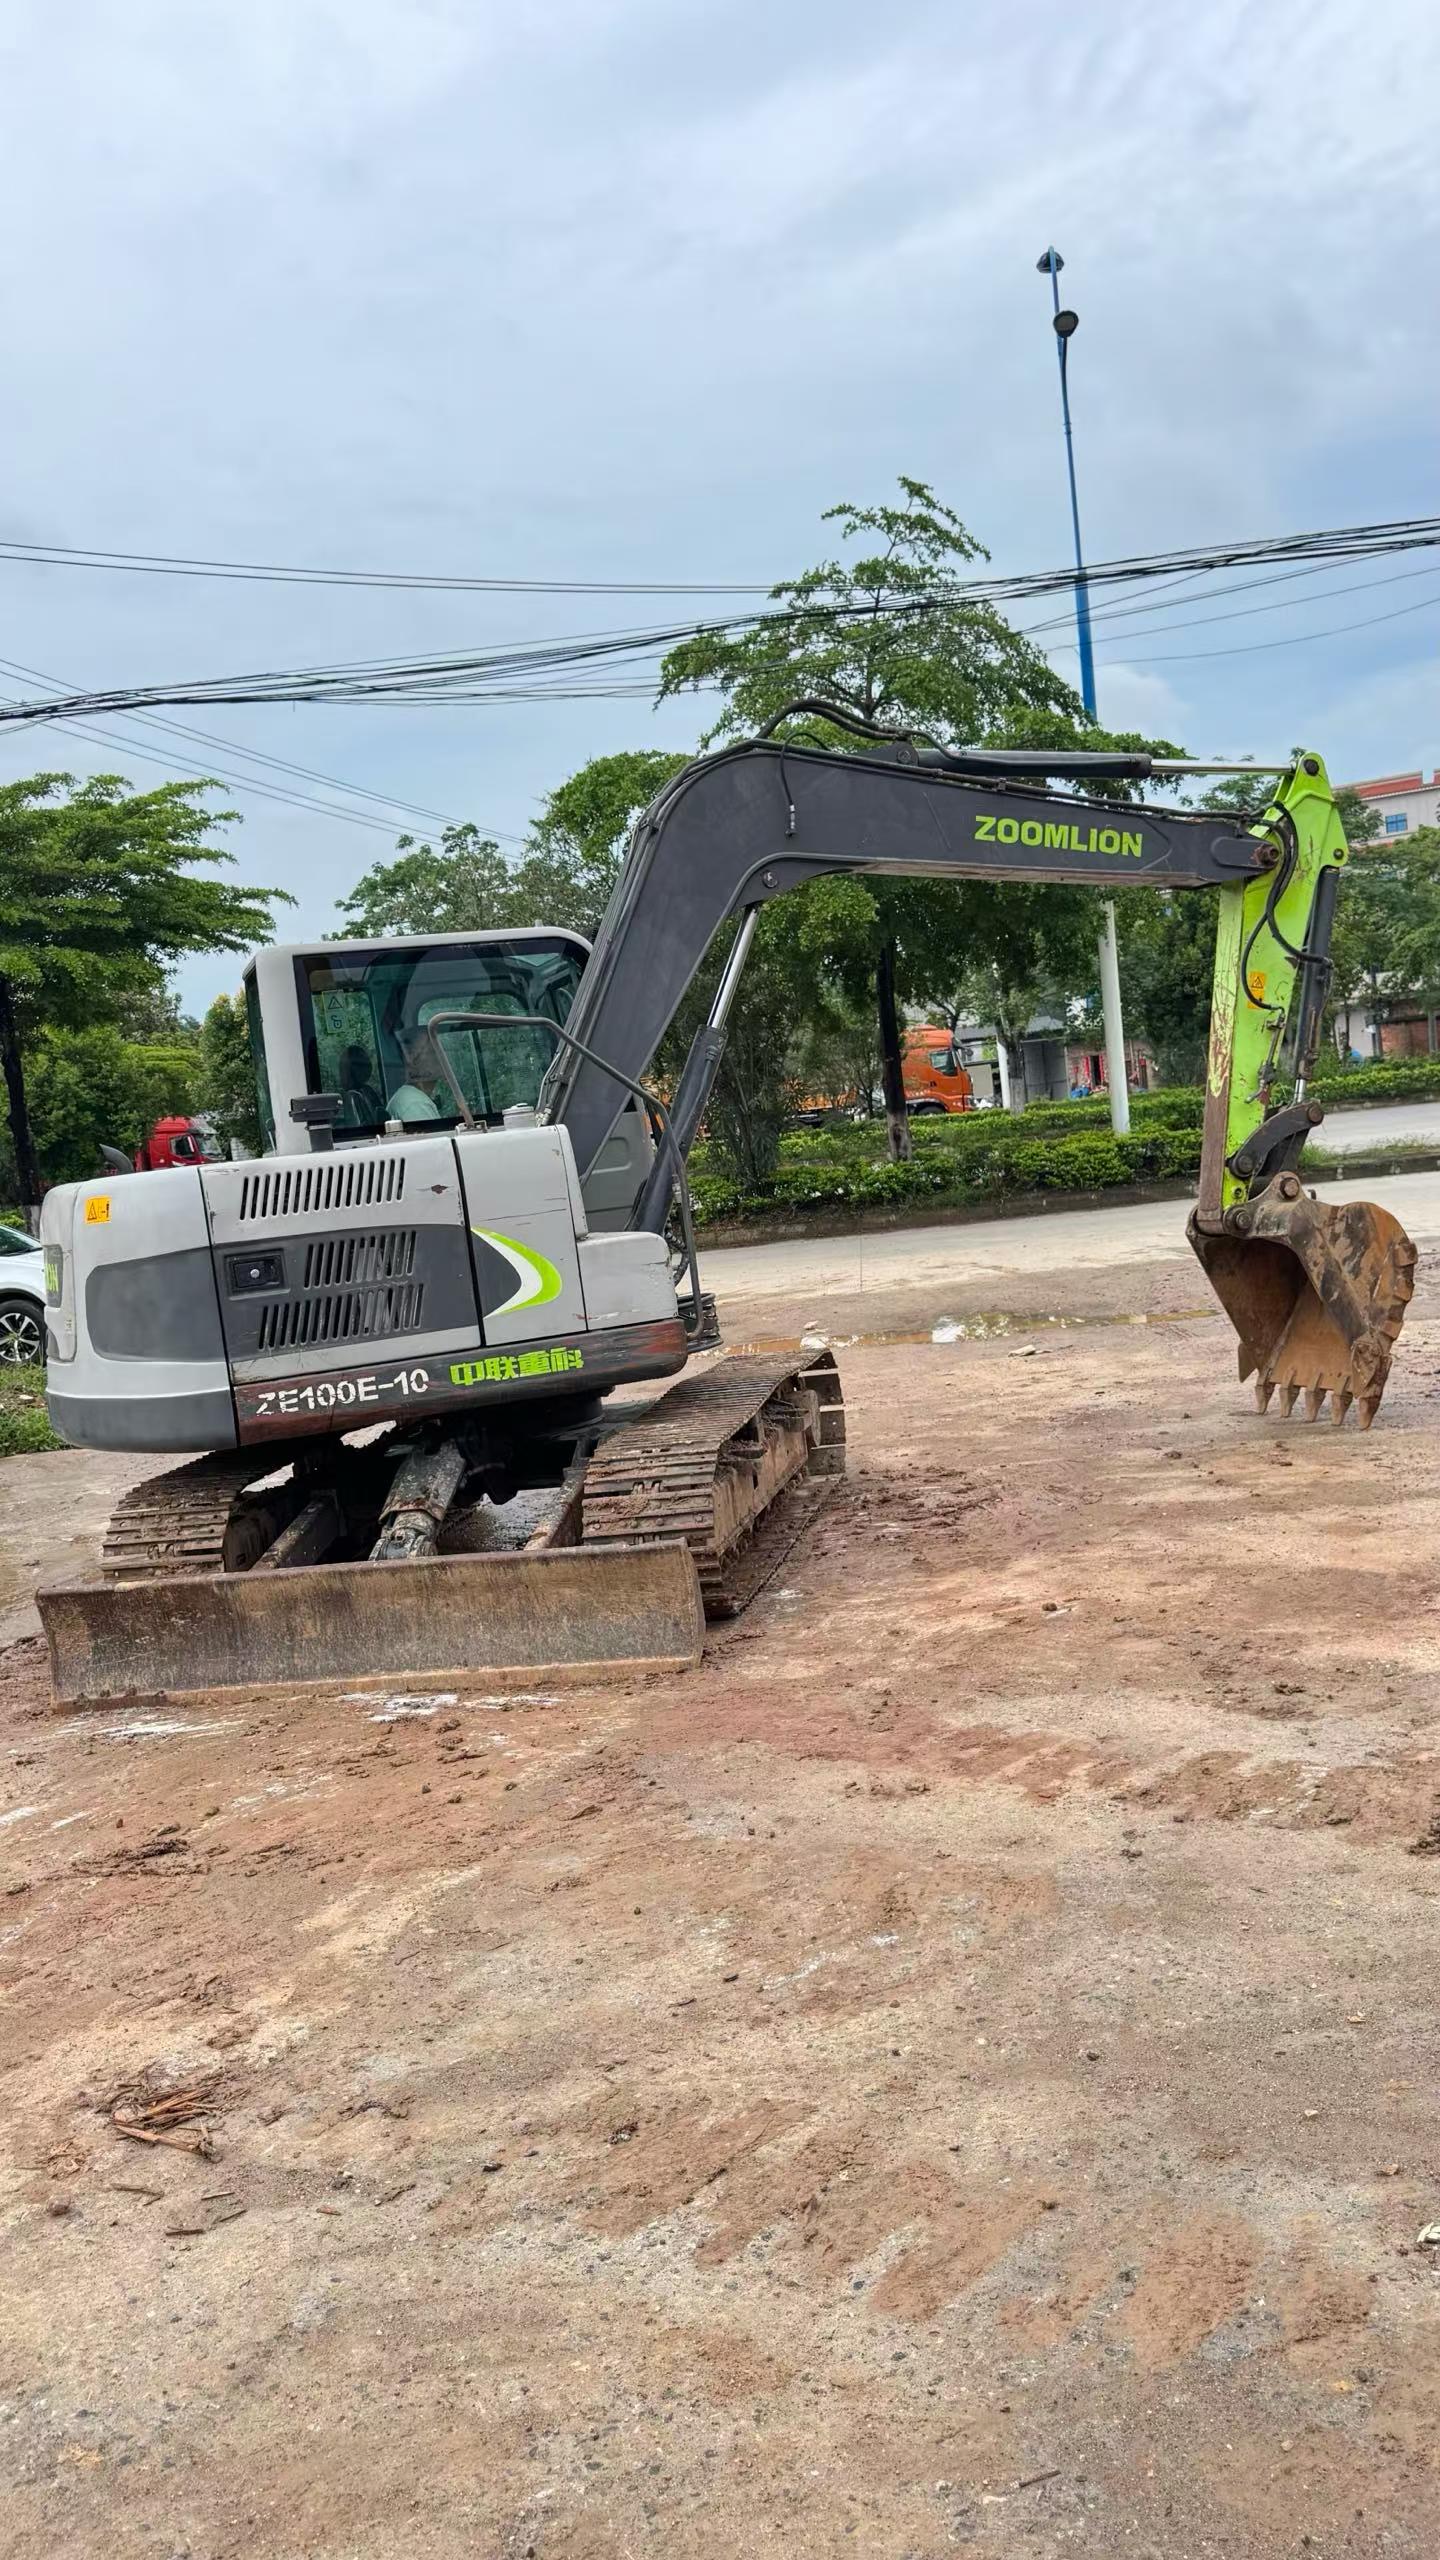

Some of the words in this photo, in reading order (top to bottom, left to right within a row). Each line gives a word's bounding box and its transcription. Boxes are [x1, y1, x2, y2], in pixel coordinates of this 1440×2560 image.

[974, 815, 1143, 858] ZOOMLION
[450, 1347, 584, 1386] 中联重科
[256, 1368, 429, 1416] ZE100E-10
